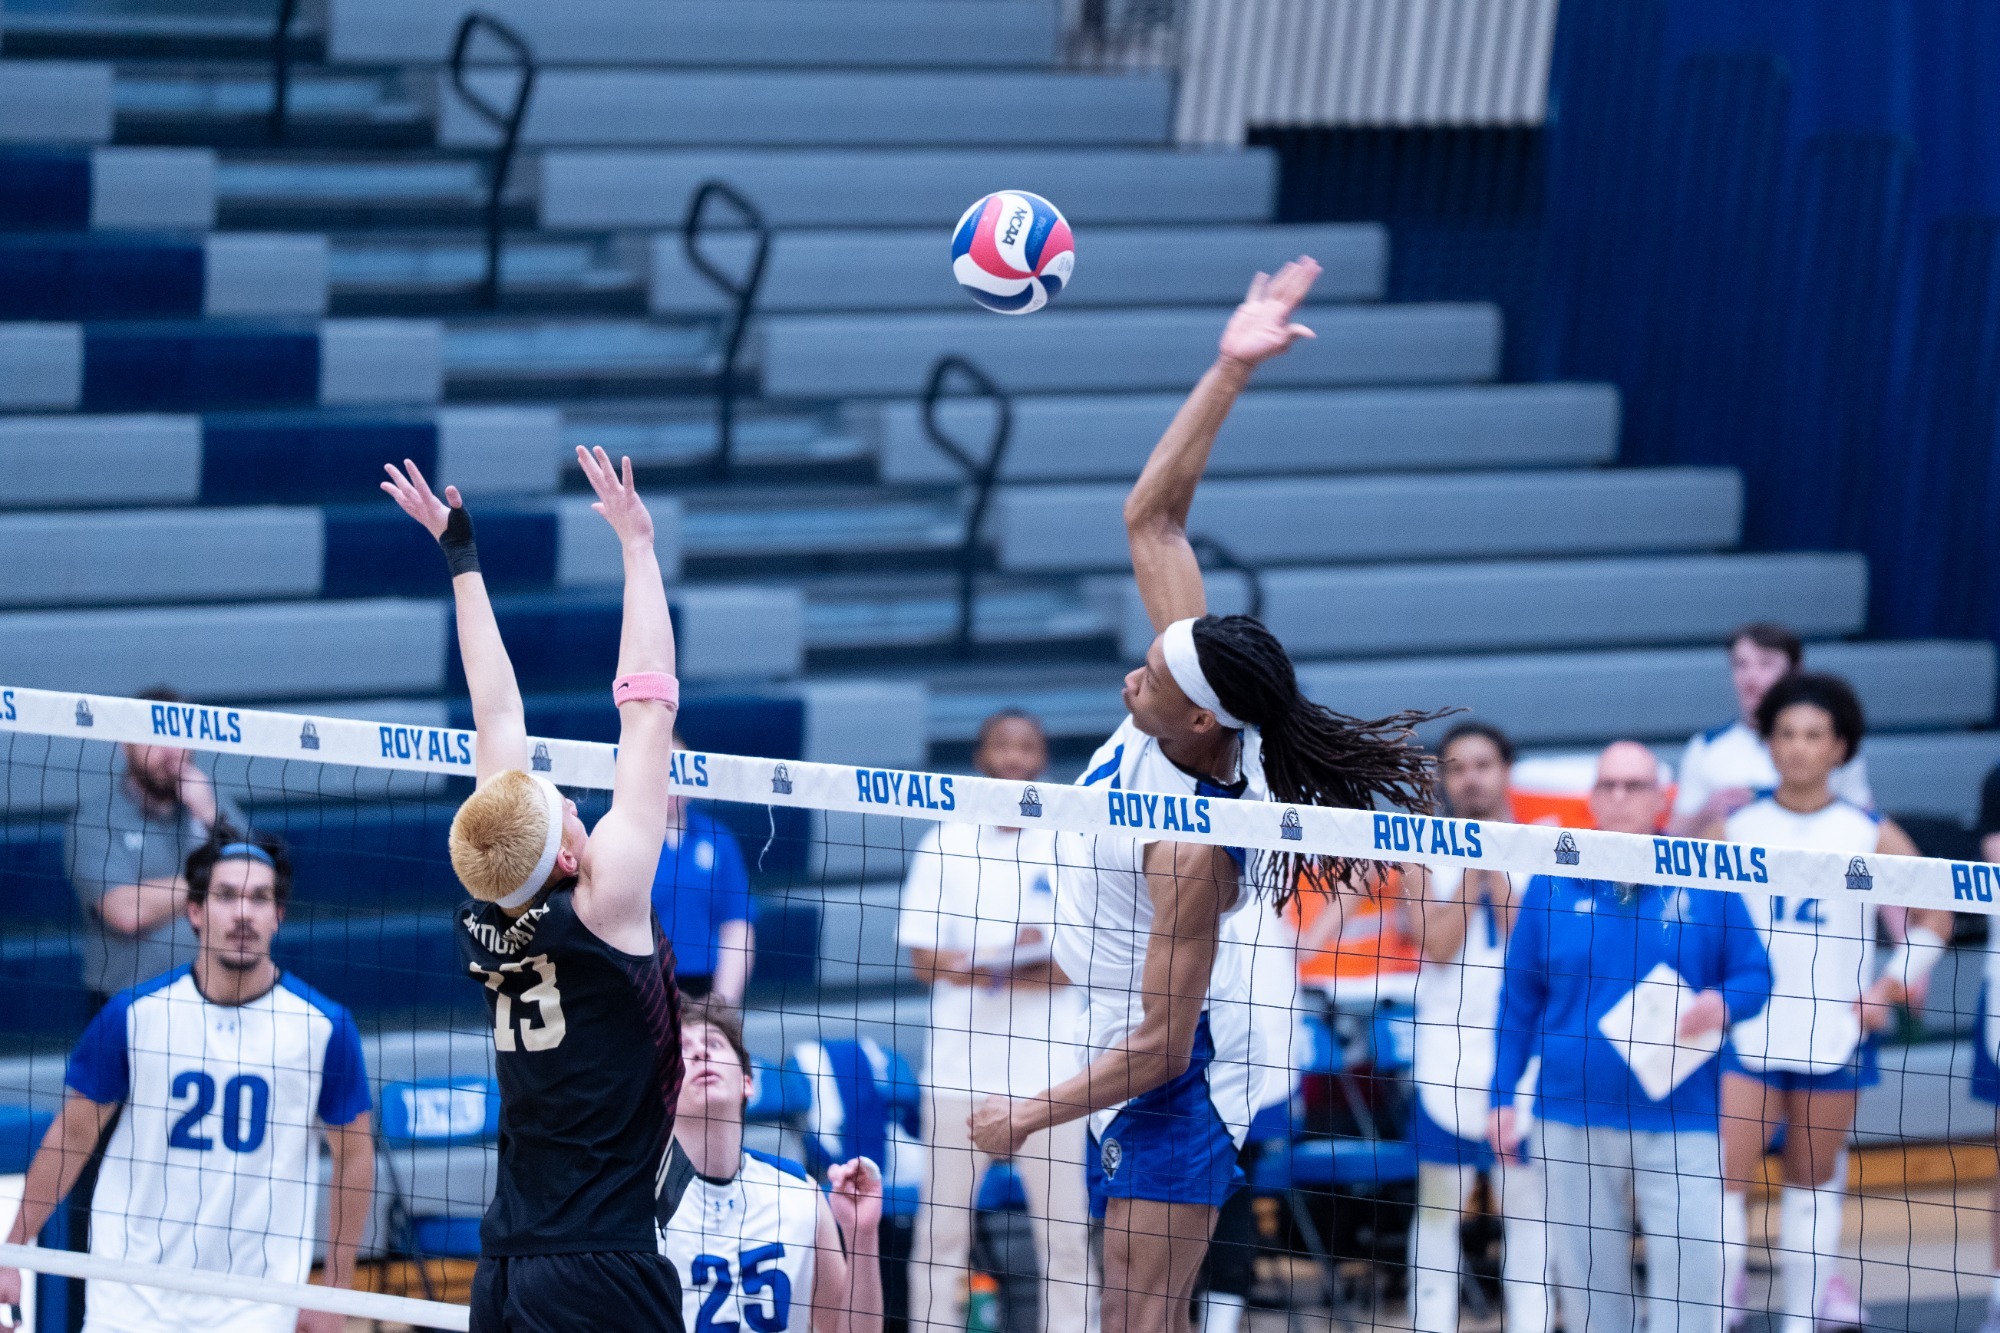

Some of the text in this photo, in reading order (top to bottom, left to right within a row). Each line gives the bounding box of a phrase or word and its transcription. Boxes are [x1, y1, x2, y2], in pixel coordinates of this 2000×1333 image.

[1002, 206, 1028, 247] NCAA
[151, 704, 242, 743] ROYALS
[379, 726, 471, 765] ROYALS
[855, 769, 956, 811] ROYALS
[1107, 791, 1211, 834] ROYALS
[1373, 813, 1483, 859] ROYALS
[1652, 839, 1769, 884] ROYALS
[469, 953, 567, 1052] 13
[166, 1070, 270, 1154] 20
[690, 1241, 792, 1333] 25
